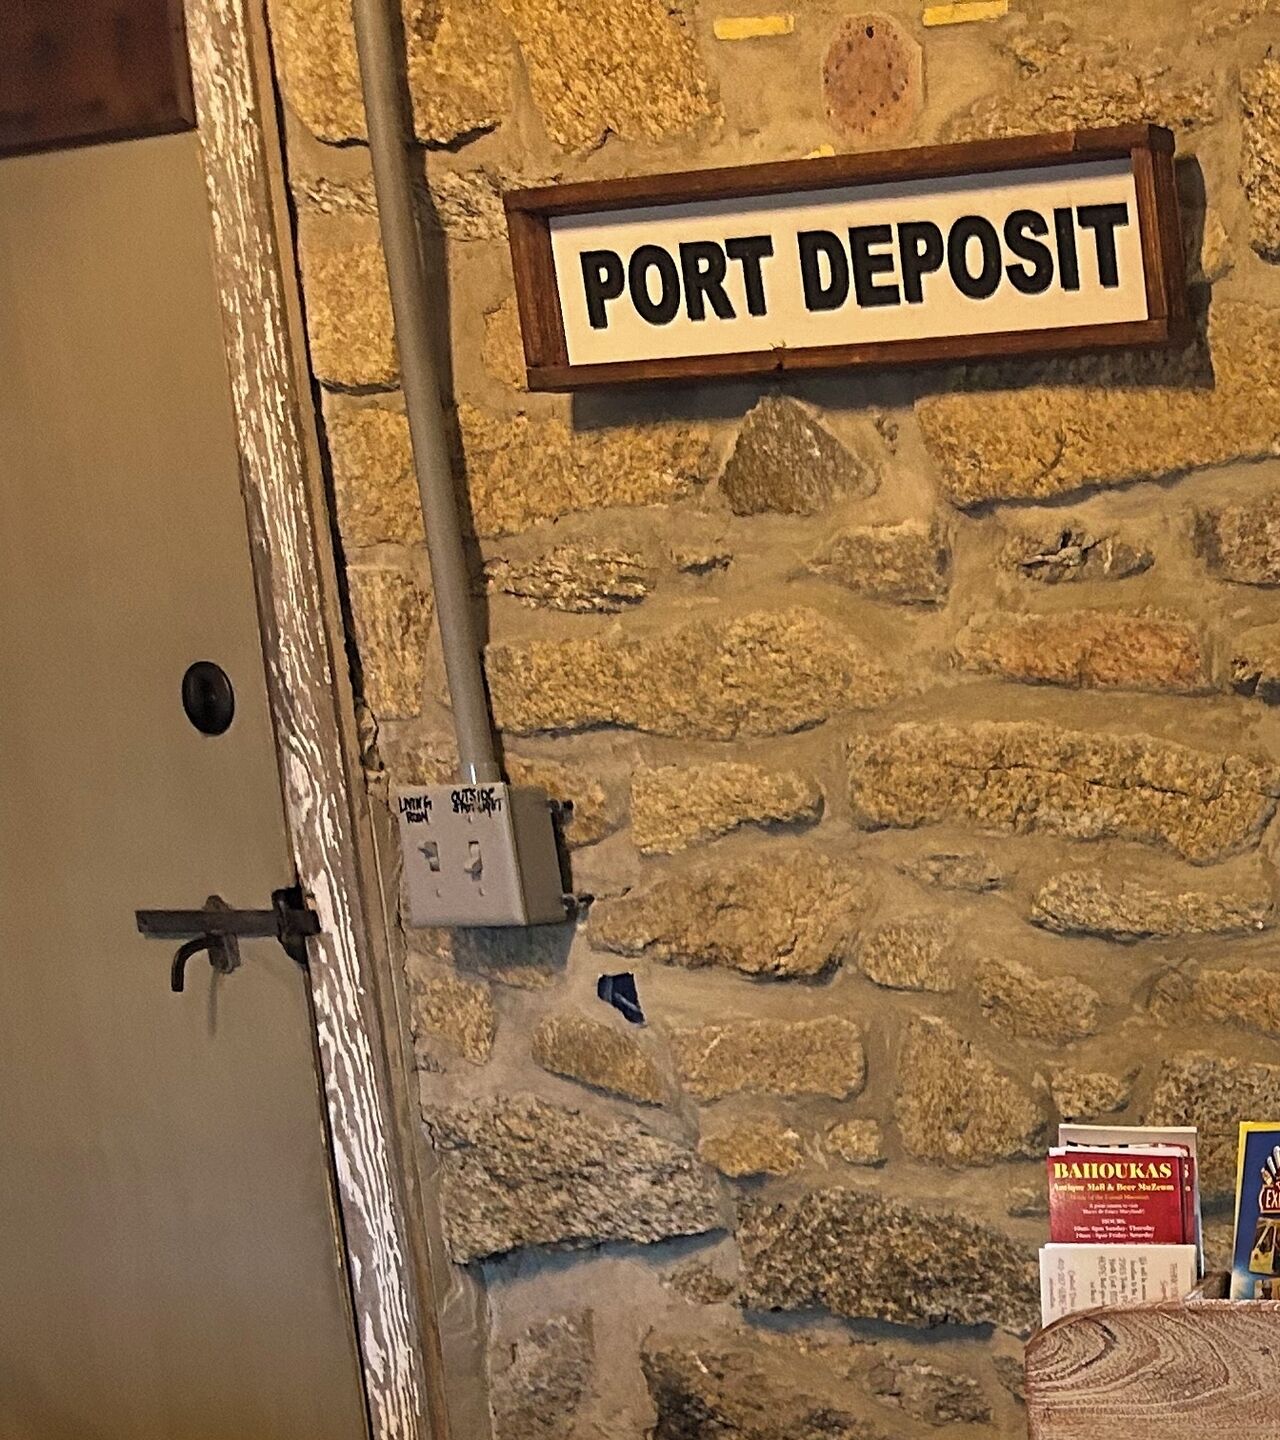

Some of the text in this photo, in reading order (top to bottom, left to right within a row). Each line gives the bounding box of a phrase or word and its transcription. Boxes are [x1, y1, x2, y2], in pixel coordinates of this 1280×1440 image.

[580, 203, 1128, 329] PORT DEPOSIT
[1053, 1162, 1173, 1180] BAHOUKAS
